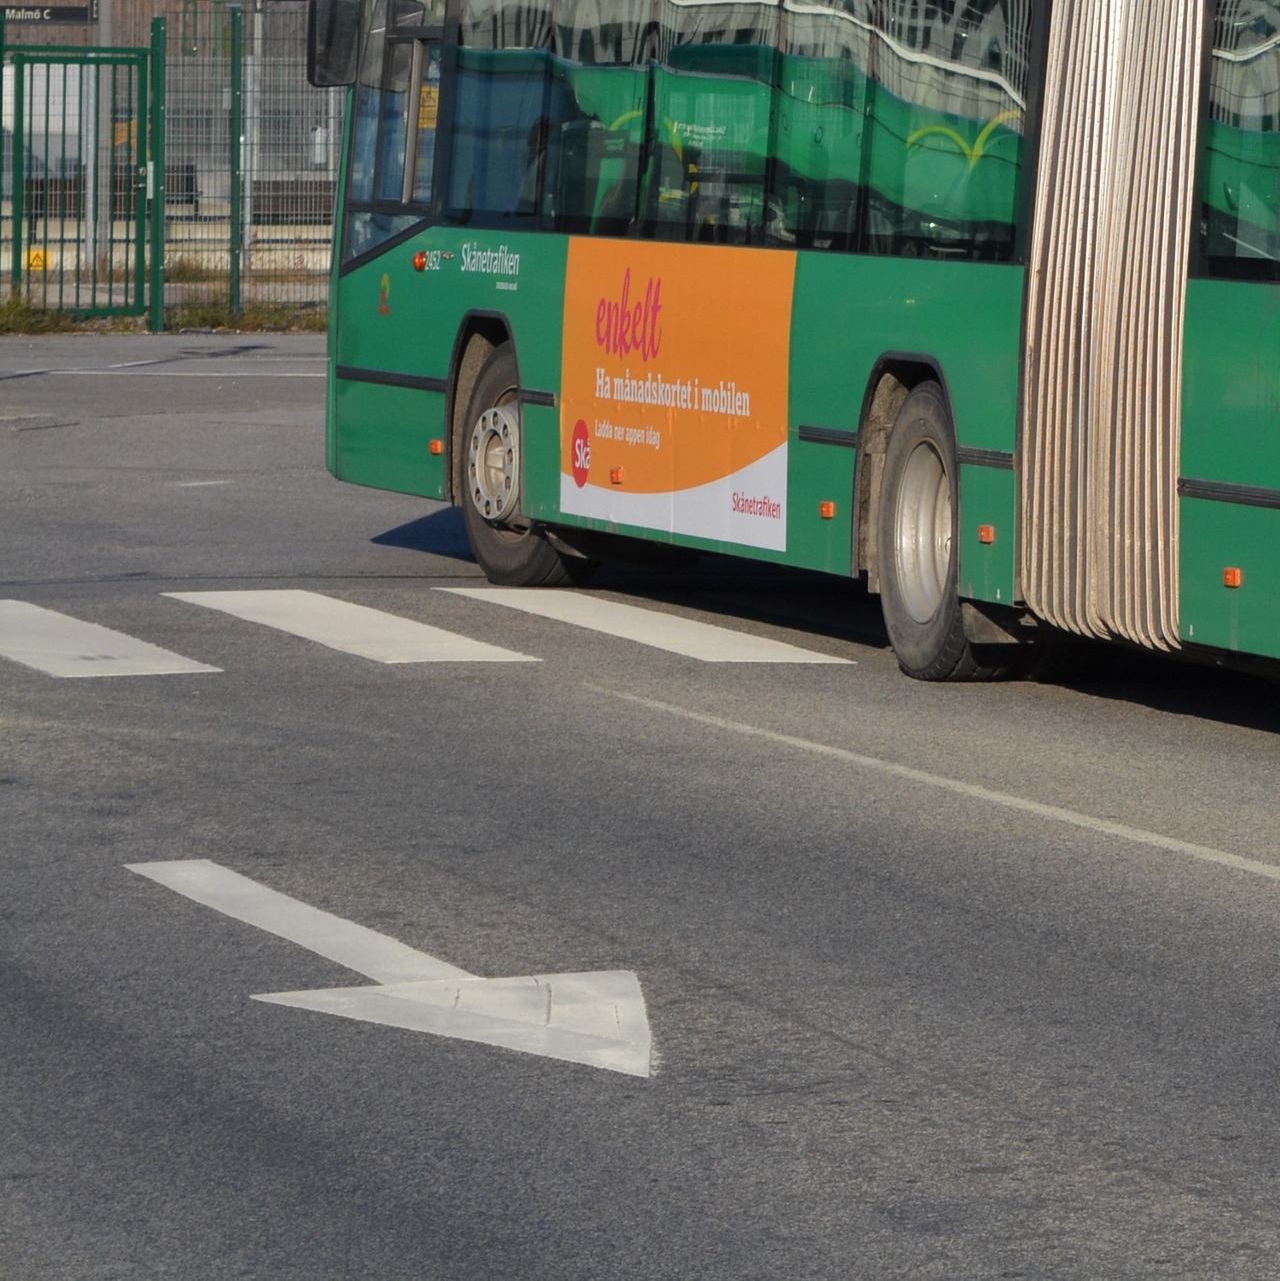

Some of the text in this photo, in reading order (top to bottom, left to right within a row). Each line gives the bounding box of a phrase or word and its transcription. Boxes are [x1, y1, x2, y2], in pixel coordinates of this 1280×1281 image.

[5, 8, 51, 19] Malmö C
[425, 250, 441, 271] 2452
[461, 242, 520, 275] Skånetrafiken
[596, 267, 662, 362] enkelt
[595, 368, 750, 416] Ha månadskortet i mobilen
[595, 419, 660, 450] Ladda ner appen idag
[732, 492, 781, 519] Skånetrafiken
